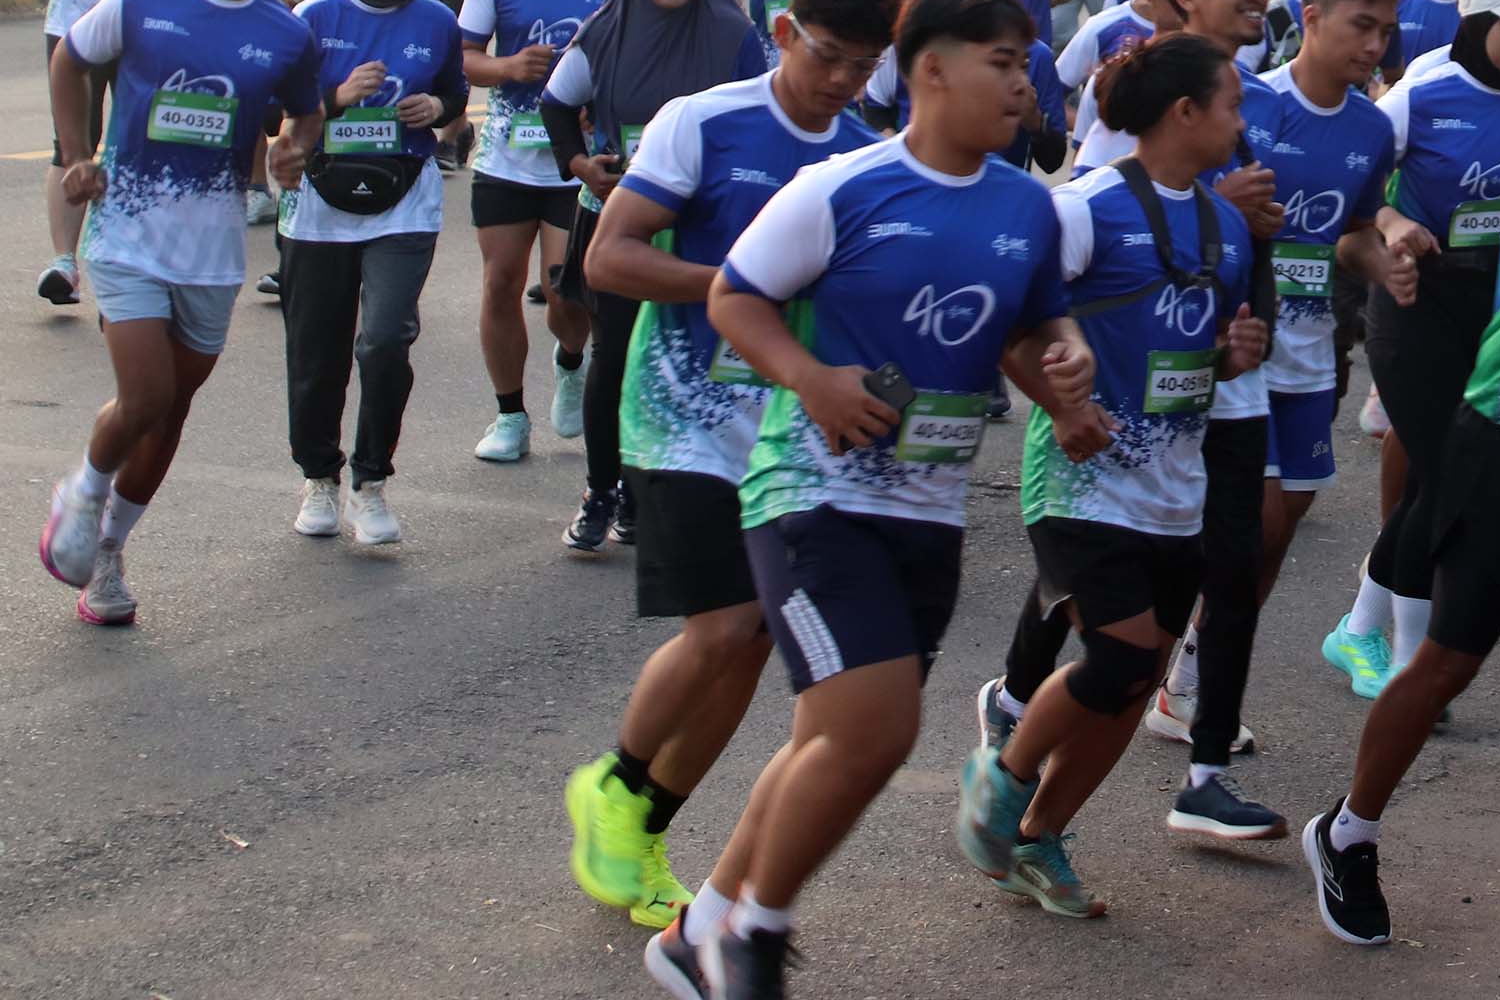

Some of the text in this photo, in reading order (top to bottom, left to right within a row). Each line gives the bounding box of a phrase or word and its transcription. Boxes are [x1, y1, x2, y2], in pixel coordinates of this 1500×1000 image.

[160, 109, 225, 132] 40-0352
[335, 125, 392, 139] 40-0341
[519, 128, 549, 139] 40-0
[1273, 263, 1325, 279] 0-0213
[903, 283, 996, 346] 40
[1154, 282, 1216, 336] 40
